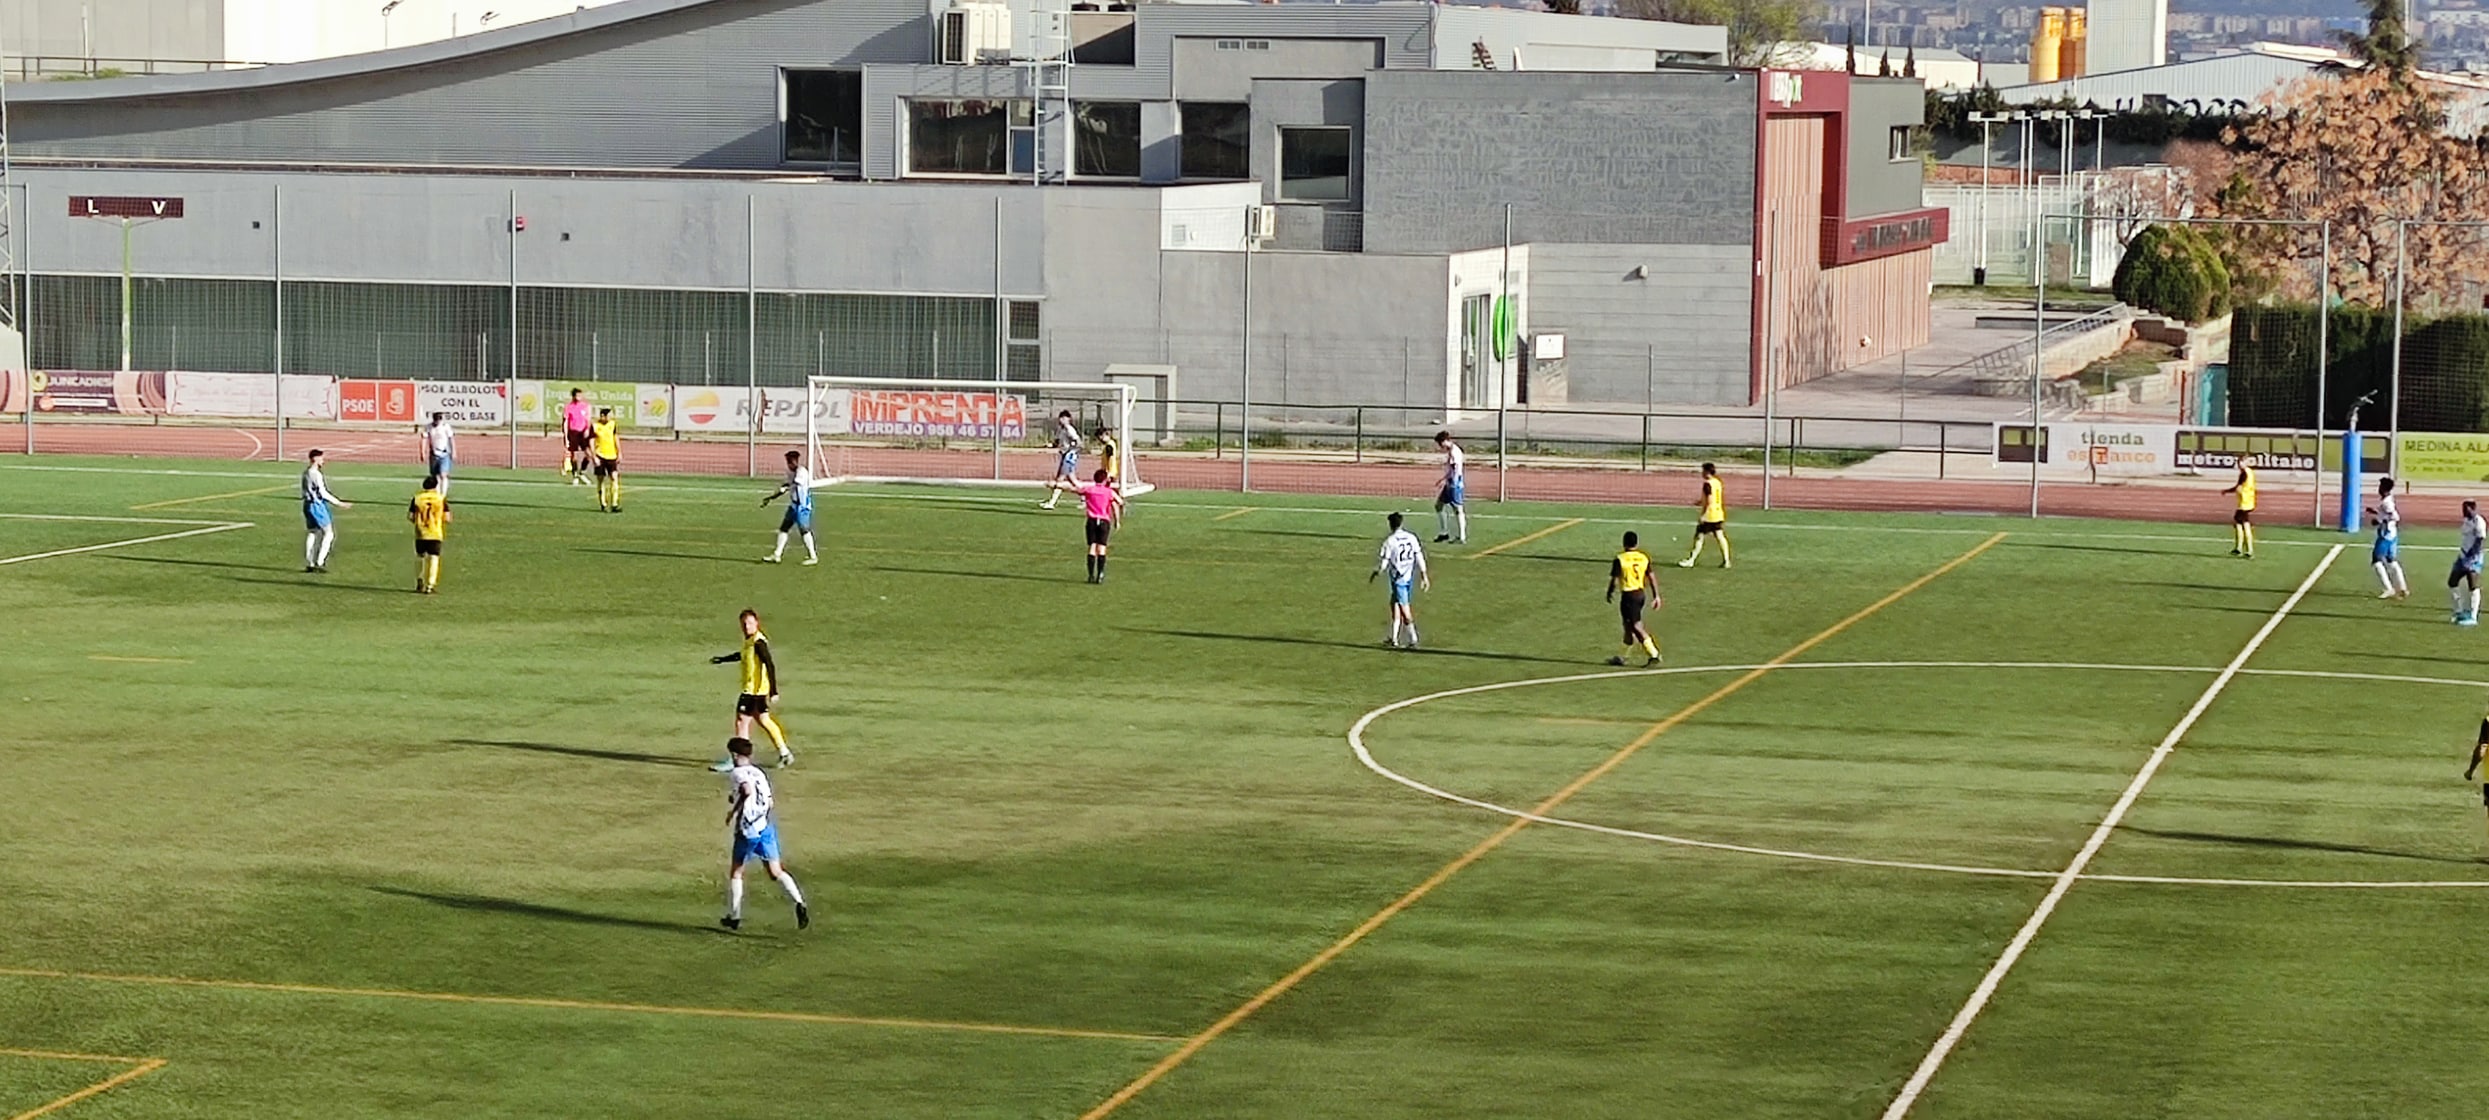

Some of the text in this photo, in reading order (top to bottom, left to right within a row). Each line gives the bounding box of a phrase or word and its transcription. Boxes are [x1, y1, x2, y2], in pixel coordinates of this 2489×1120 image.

[87, 199, 167, 215] L V
[342, 398, 376, 414] PSOE
[441, 397, 481, 408] CON EL
[851, 389, 1024, 427] IMPRENTA
[470, 411, 497, 421] BASE
[854, 421, 924, 436] VERDEJO
[927, 424, 954, 437] 958
[958, 426, 977, 437] 46
[1002, 426, 1021, 438] 84
[2404, 440, 2462, 452] MEDINA
[1399, 542, 1413, 562] 22
